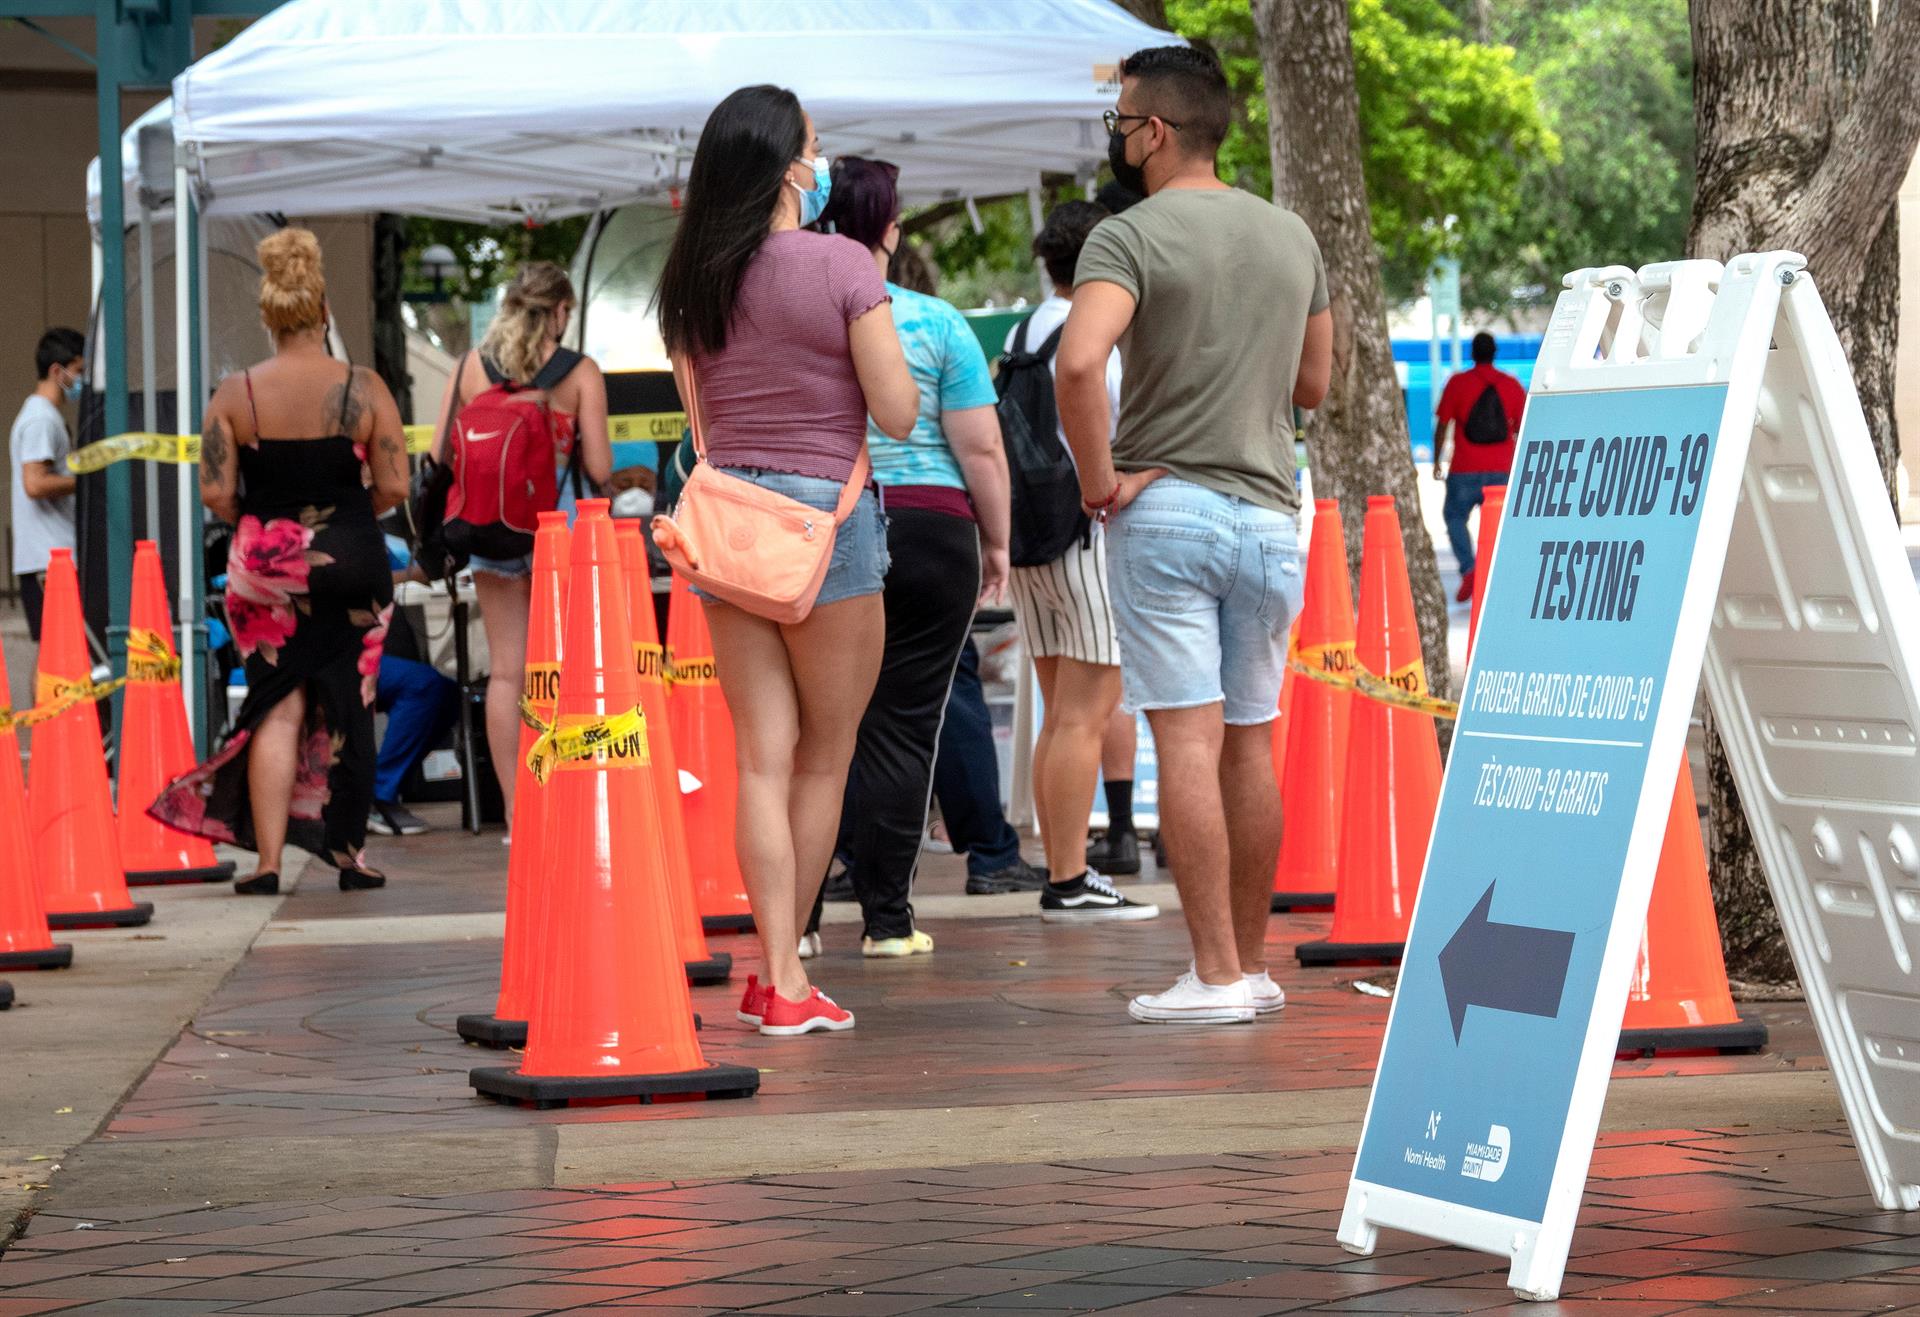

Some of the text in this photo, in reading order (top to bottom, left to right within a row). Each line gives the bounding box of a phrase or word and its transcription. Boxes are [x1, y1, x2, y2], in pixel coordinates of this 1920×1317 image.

[1512, 432, 1710, 518] FREE COVID-19
[1530, 539, 1645, 622] TESTING
[1471, 669, 1524, 714] PRUEBA
[1521, 672, 1572, 717] GRATIS
[1567, 674, 1593, 719] DE
[1588, 674, 1654, 722] COVID-19
[1473, 754, 1609, 817] TÈS COVID-19 GRATIS
[1404, 1146, 1447, 1171] Nomi Health
